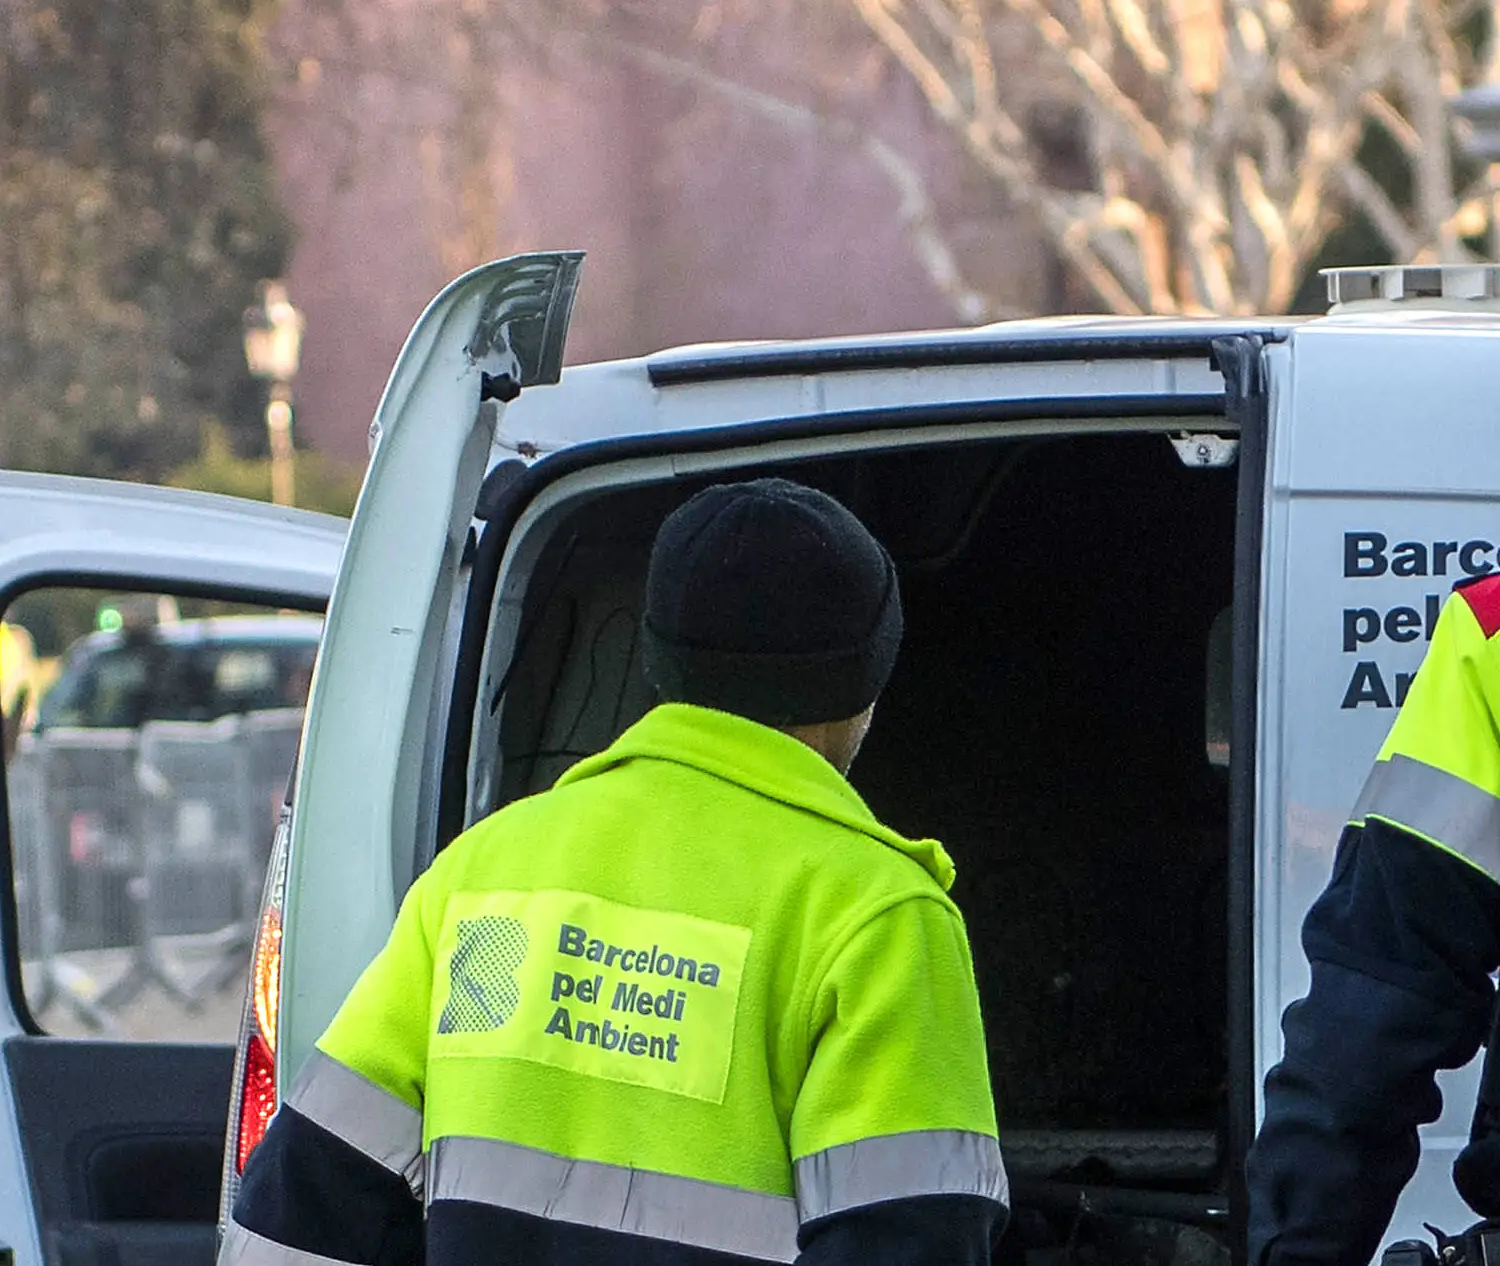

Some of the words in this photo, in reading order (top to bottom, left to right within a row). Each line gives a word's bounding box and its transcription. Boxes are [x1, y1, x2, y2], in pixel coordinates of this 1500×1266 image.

[1343, 532, 1499, 577] Barc
[1343, 595, 1440, 652] pel
[558, 923, 721, 987] Barcelona
[551, 971, 603, 1004] pel
[611, 982, 687, 1021] Medi
[544, 1006, 680, 1062] Ambient
